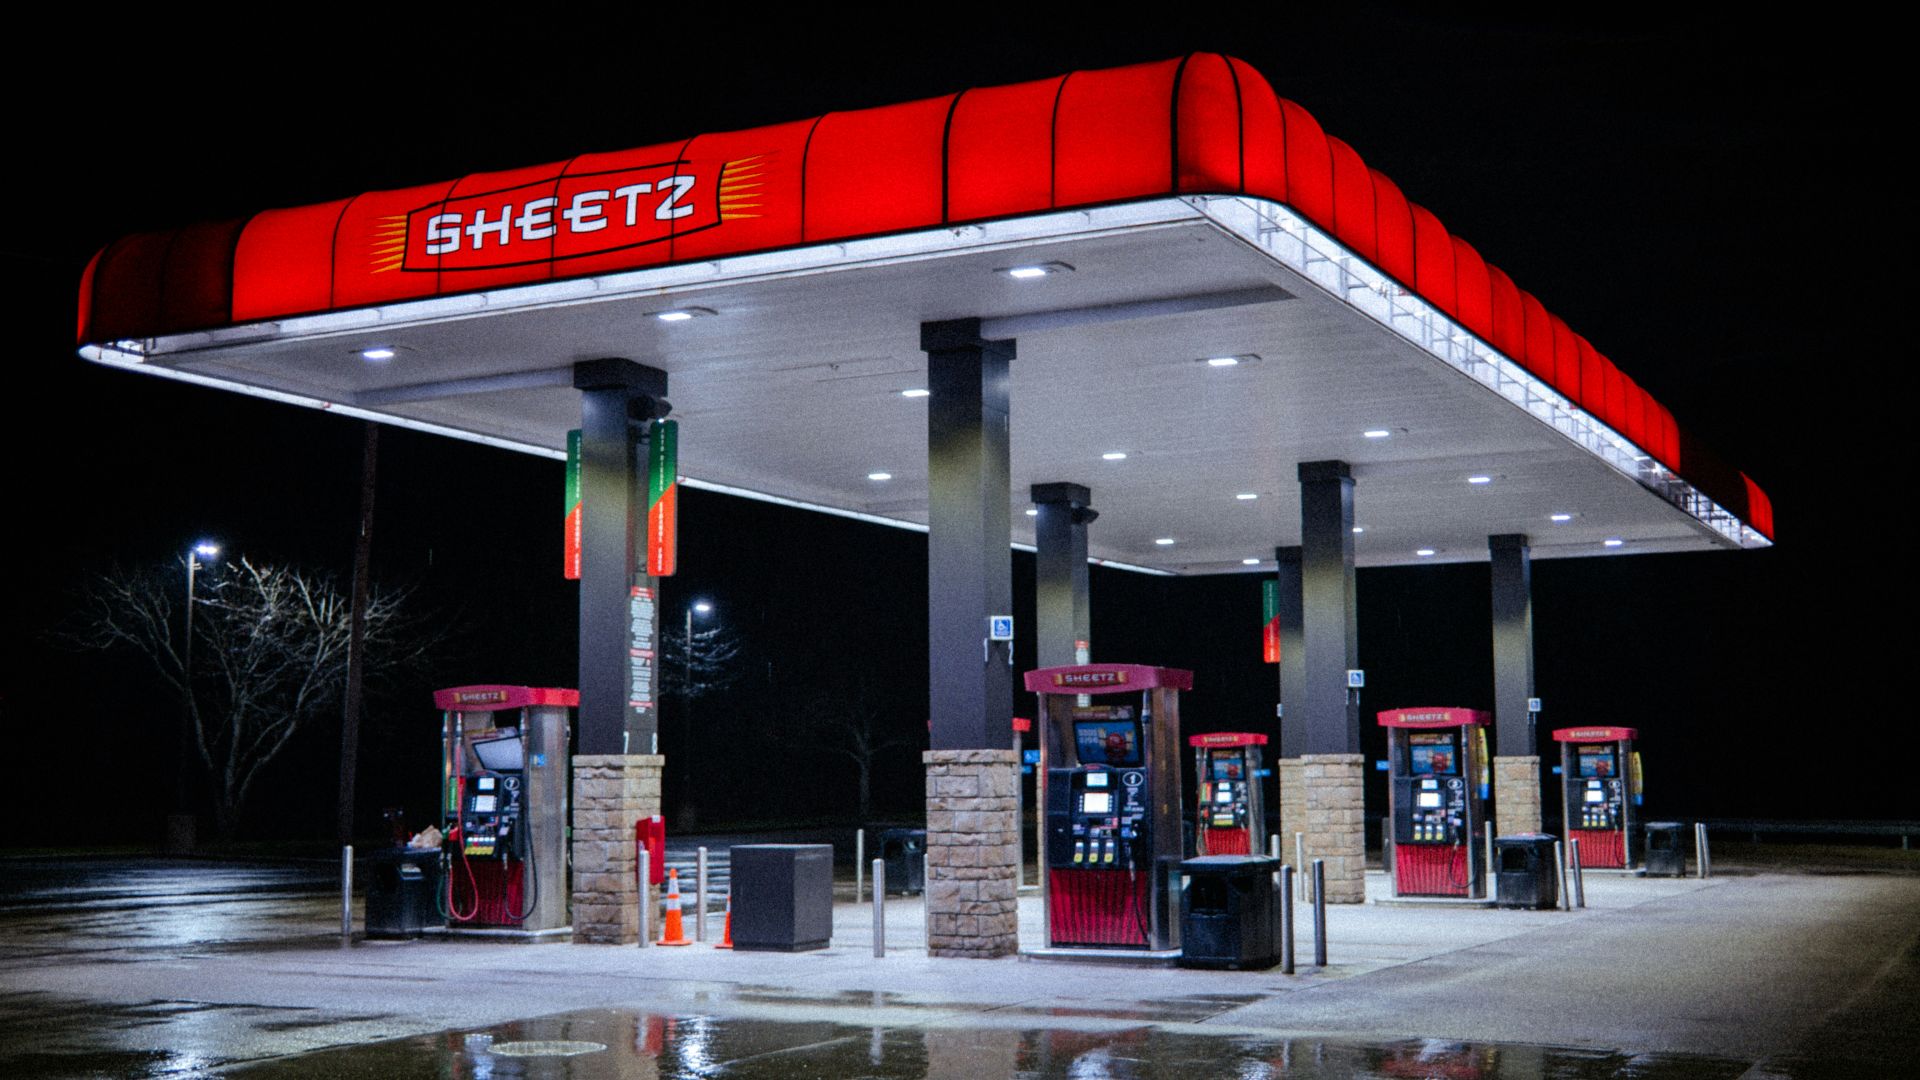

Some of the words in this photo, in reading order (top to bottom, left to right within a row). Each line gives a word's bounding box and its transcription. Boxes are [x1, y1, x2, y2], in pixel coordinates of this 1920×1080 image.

[426, 174, 696, 256] SHEETZ
[1065, 673, 1115, 683] SHEETZ
[1129, 774, 1136, 784] 1
